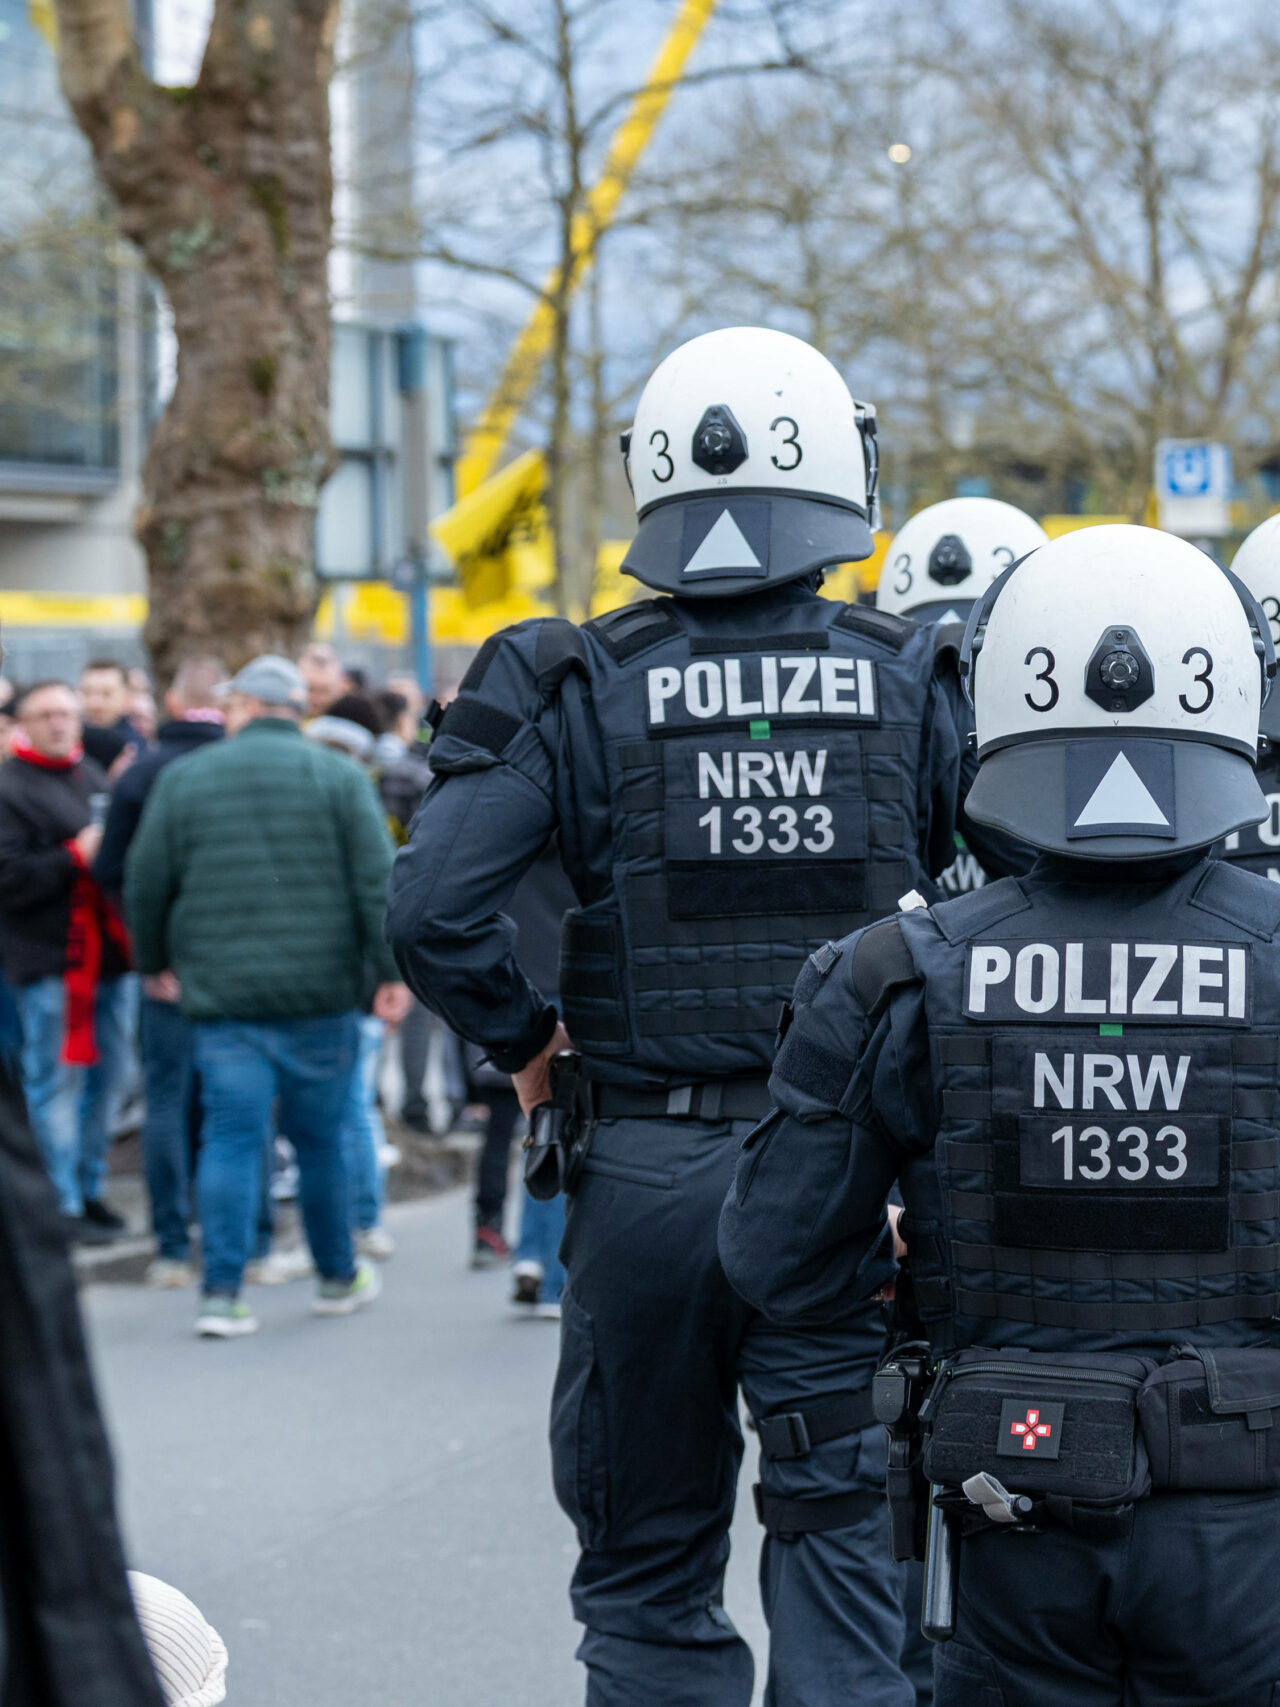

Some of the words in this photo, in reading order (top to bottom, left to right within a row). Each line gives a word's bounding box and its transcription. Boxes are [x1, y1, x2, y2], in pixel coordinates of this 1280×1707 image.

[650, 430, 674, 483] 3
[770, 417, 803, 471] 3
[894, 554, 913, 595] 3
[648, 657, 875, 724] POLIZEI
[1025, 647, 1059, 712] 3
[1179, 647, 1214, 714] 3
[698, 750, 827, 799] NRW
[699, 805, 835, 854] 1333
[969, 943, 1246, 1019] POLIZEI
[1033, 1053, 1191, 1111] NRW
[1051, 1125, 1188, 1181] 1333
